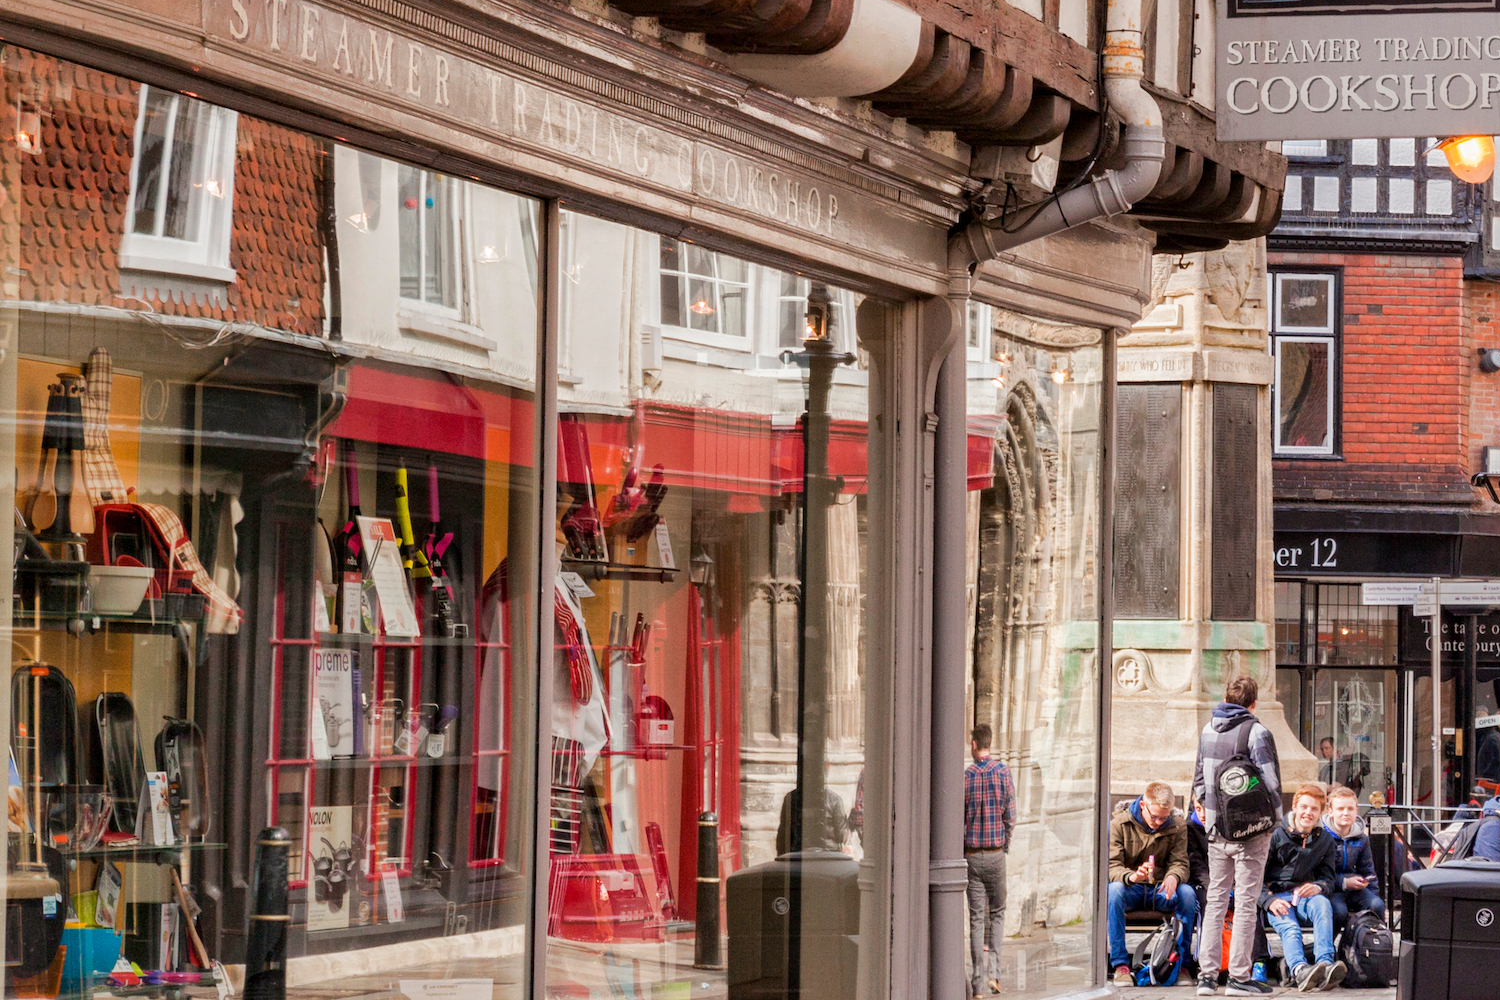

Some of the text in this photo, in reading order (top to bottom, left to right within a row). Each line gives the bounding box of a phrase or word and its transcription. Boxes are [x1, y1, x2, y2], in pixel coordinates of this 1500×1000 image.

[1226, 39, 1361, 65] STEAMER
[487, 72, 650, 177] TRADING
[677, 142, 840, 233] COOKSHOP
[1310, 538, 1337, 567] 12
[1421, 618, 1448, 634] Te
[1454, 622, 1486, 634] tae
